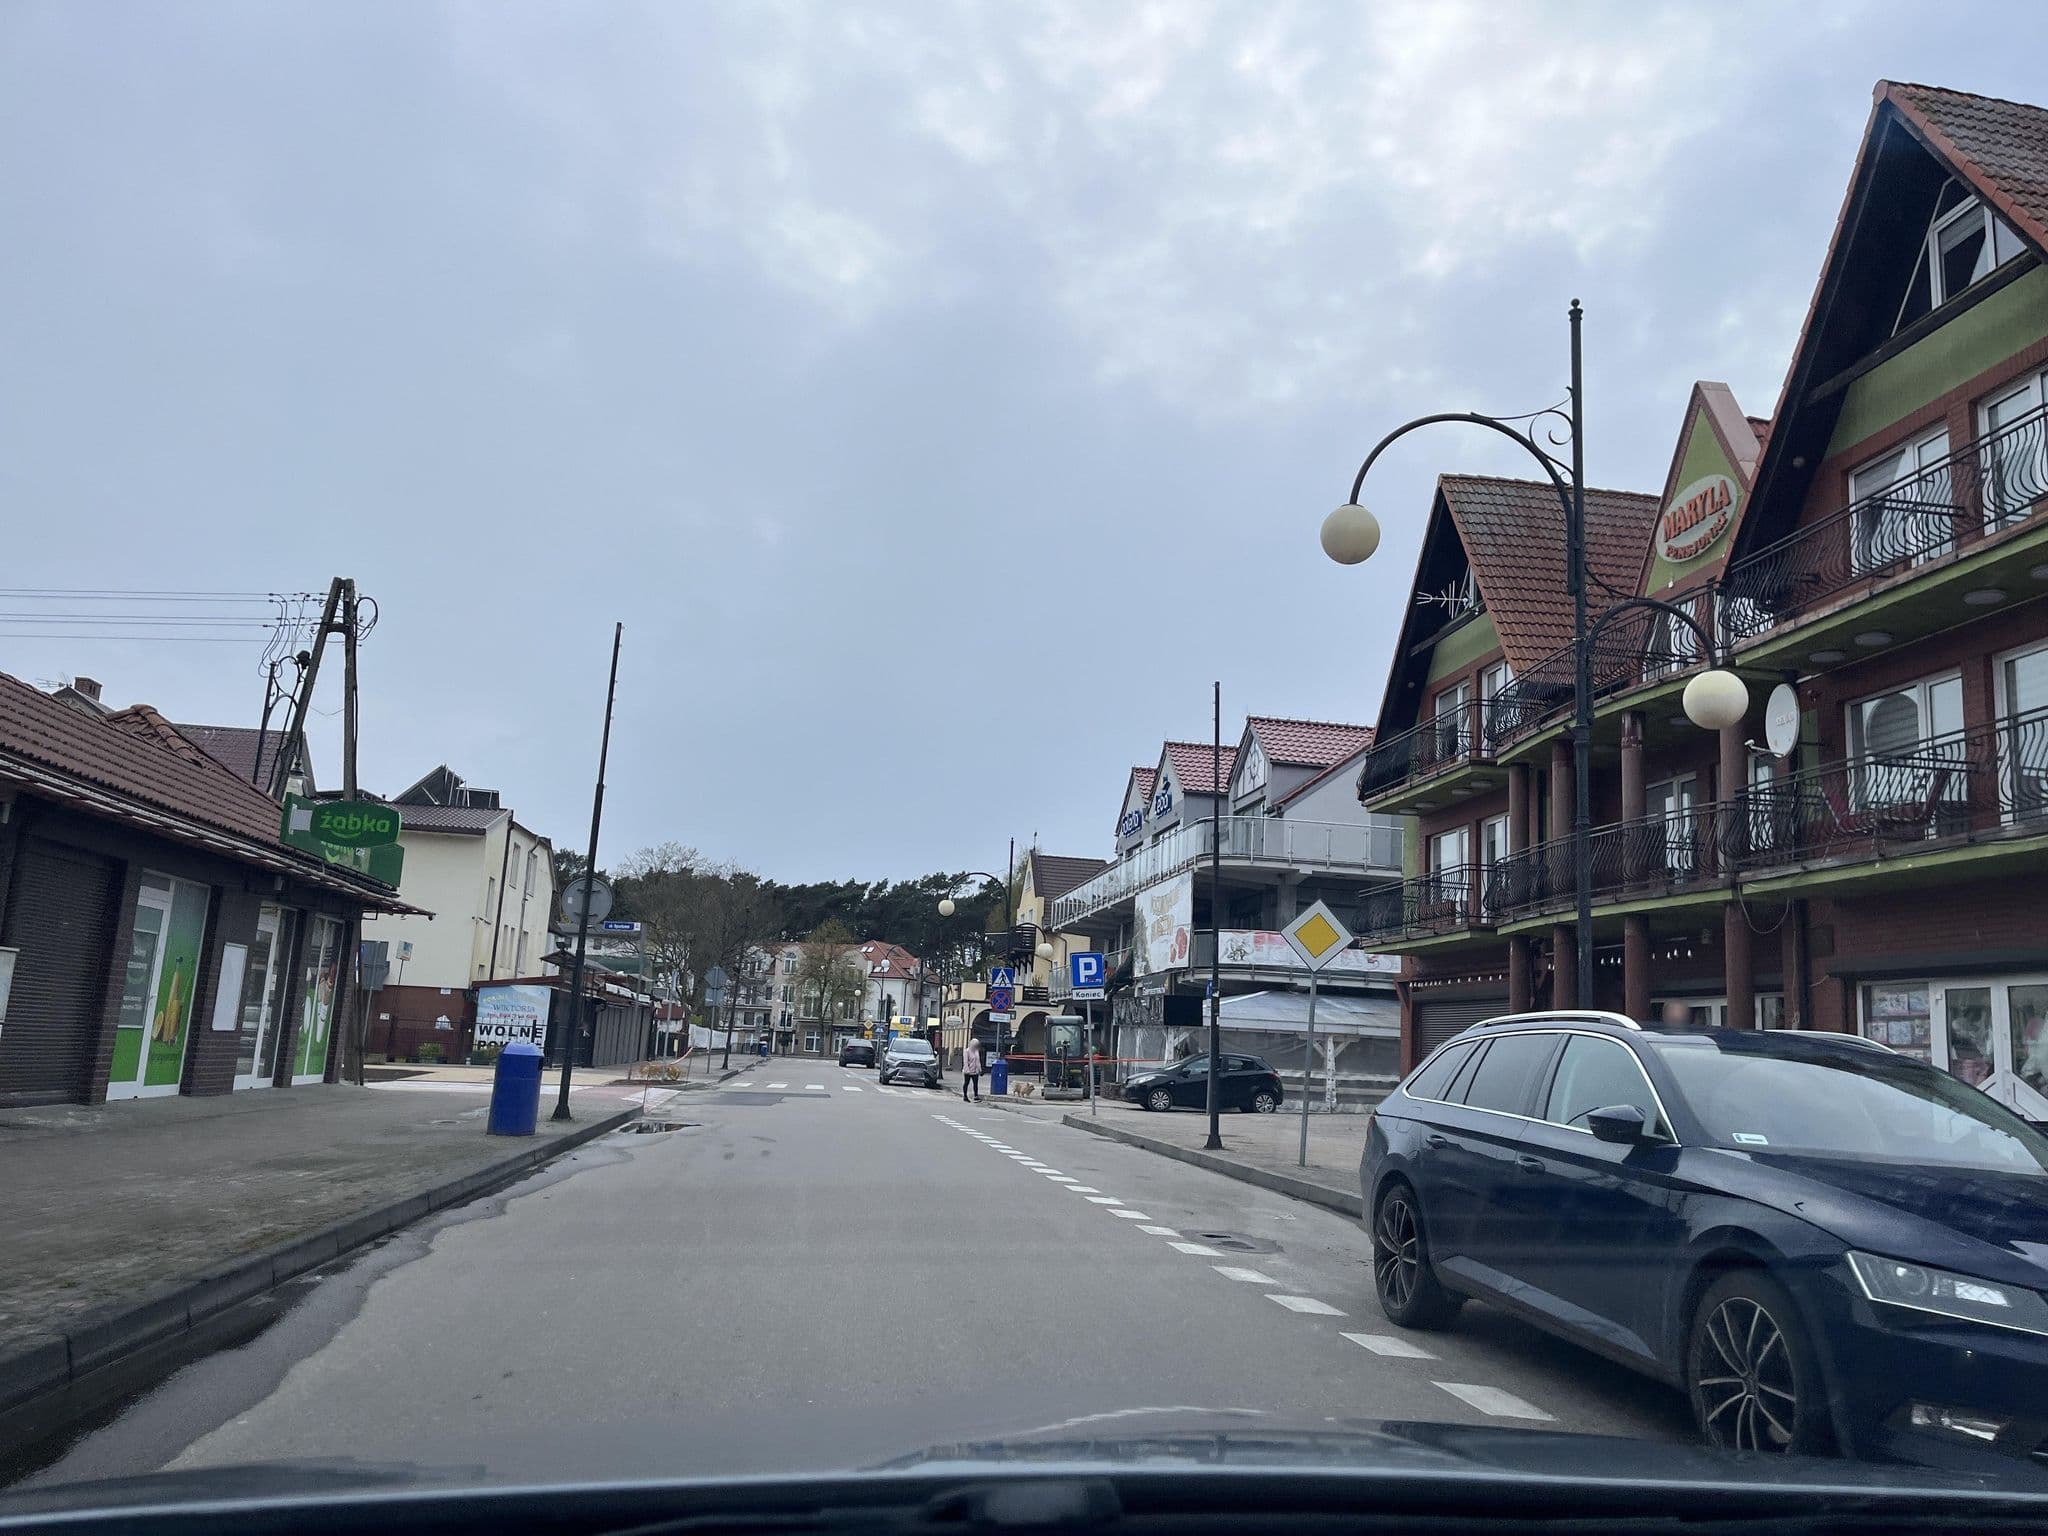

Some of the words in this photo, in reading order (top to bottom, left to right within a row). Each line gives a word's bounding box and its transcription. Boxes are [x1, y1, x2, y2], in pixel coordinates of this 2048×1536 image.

[1663, 480, 1731, 542] MARYLA
[320, 812, 390, 833] żabka
[1079, 957, 1097, 983] P
[479, 1025, 543, 1039] WOLNE
